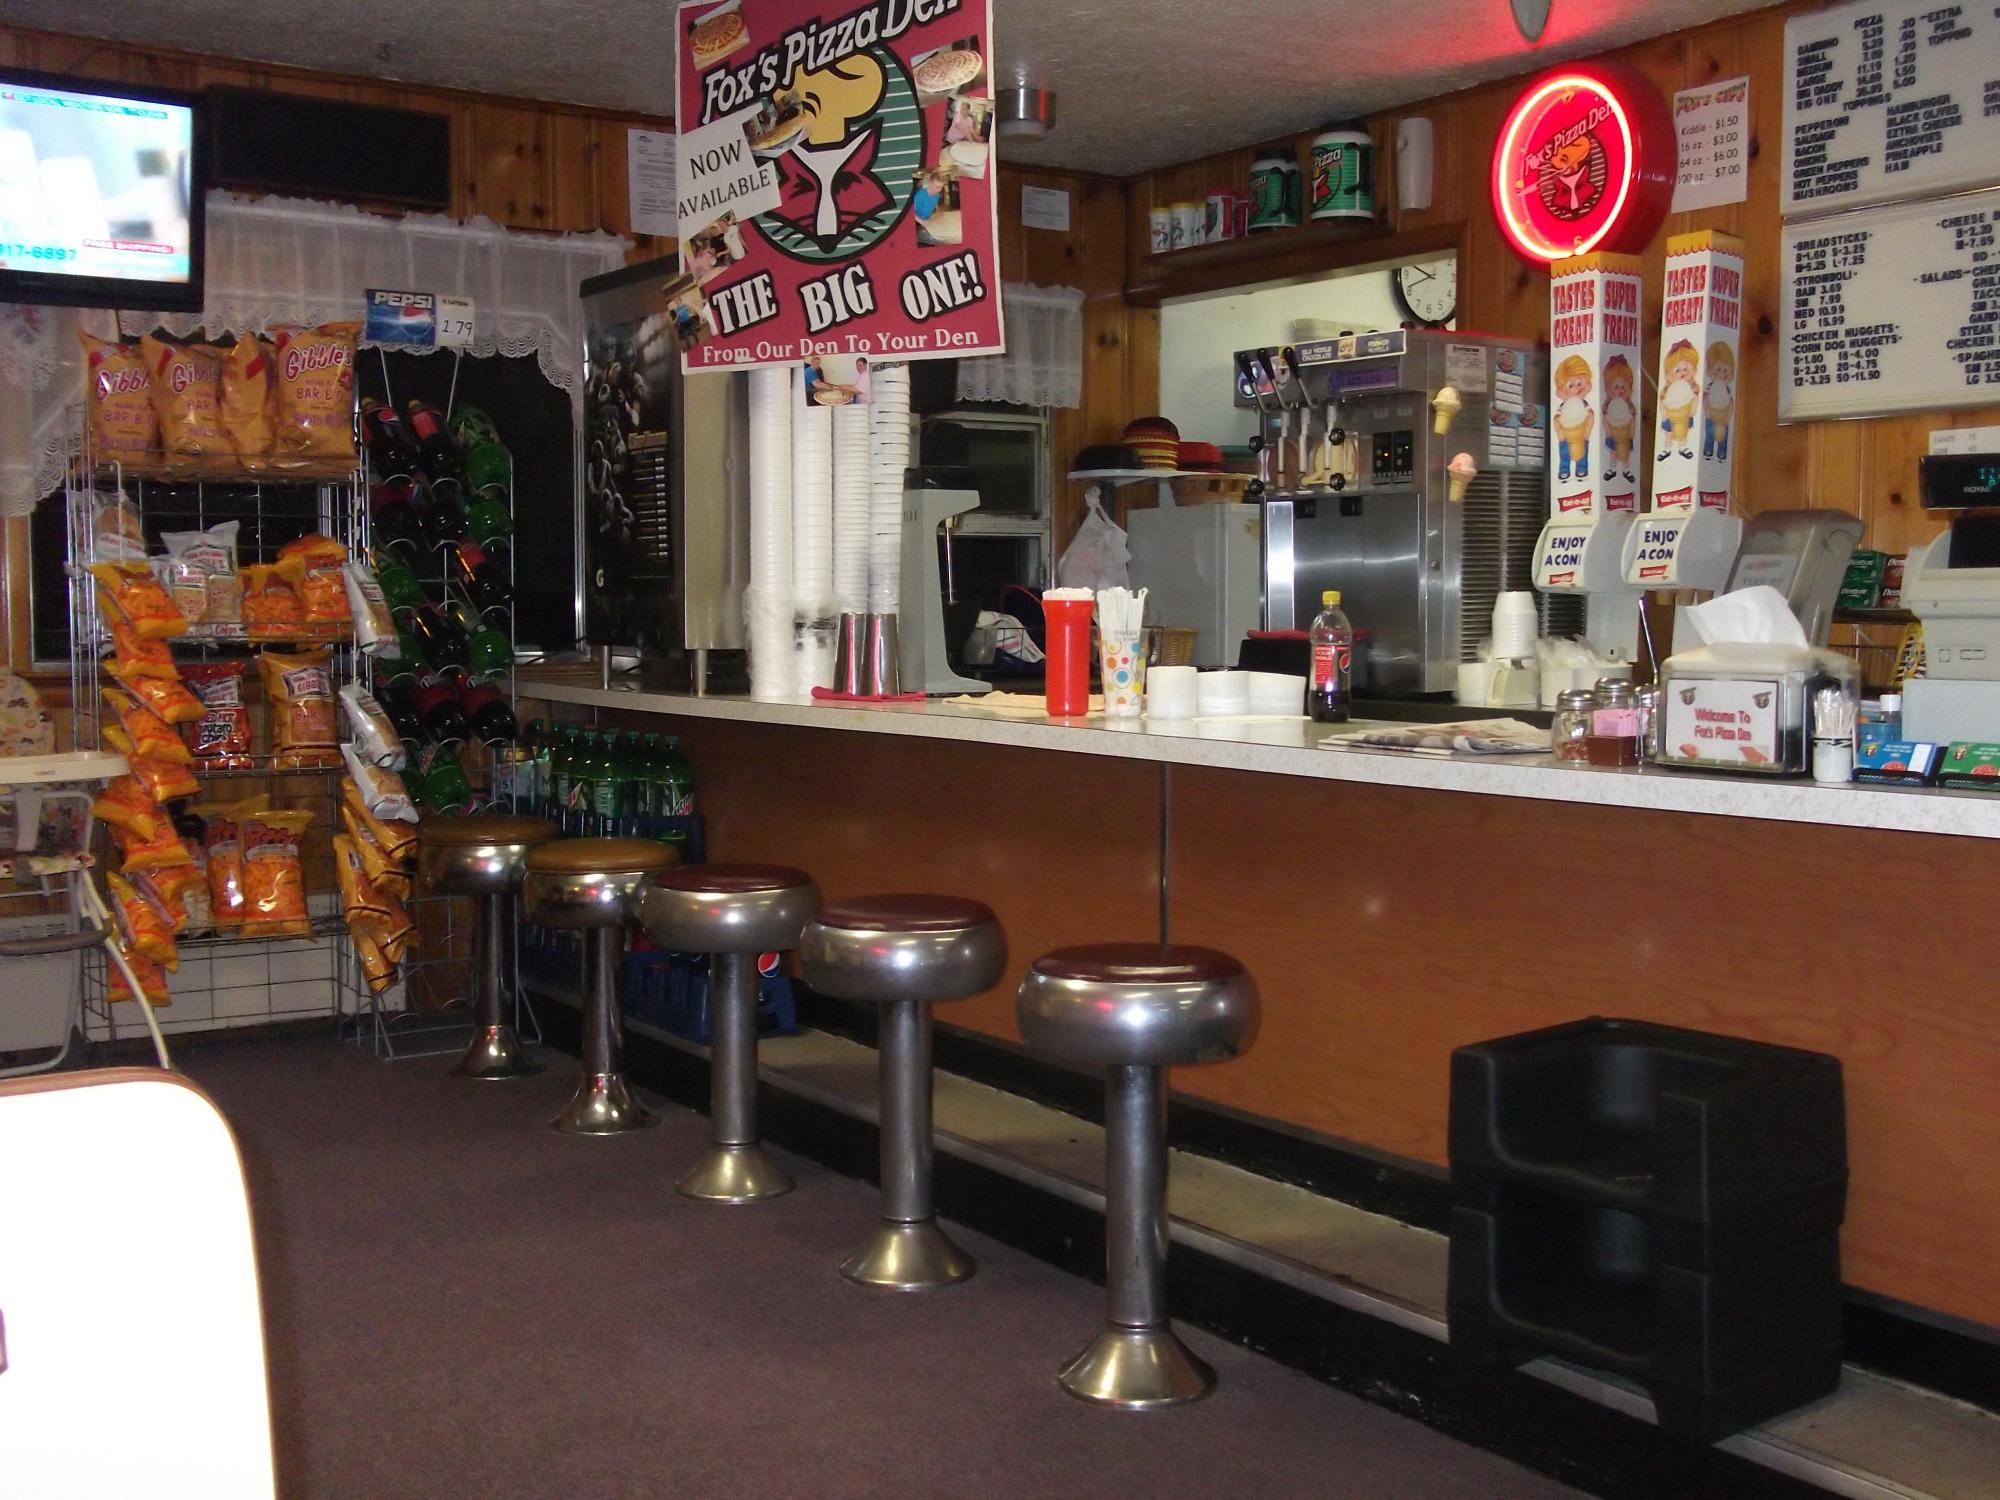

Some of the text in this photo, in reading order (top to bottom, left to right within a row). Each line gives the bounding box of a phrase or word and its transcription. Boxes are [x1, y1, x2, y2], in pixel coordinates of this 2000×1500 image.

[703, 0, 957, 124] Fox's Pizza Den
[1553, 120, 1588, 155] Pizza
[1794, 115, 1849, 135] PEPPERONI
[689, 139, 742, 180] NOW
[1793, 178, 1811, 190] HOT
[1884, 160, 1910, 174] HAM
[1826, 156, 1870, 173] PEPPERS
[677, 167, 771, 220] AVAILABLE
[1793, 180, 1859, 200] MUSHROOMS
[712, 253, 984, 335] THE BIG ONE!
[1553, 279, 1595, 315] TASTES
[1603, 280, 1637, 314] SUPER
[1666, 264, 1707, 298] TASTES
[1711, 266, 1740, 298] SUPER
[374, 291, 433, 309] PEPSI
[1665, 296, 1704, 328] GREAT!
[1710, 296, 1739, 330] TREAT!
[442, 319, 473, 337] 1.79
[1553, 313, 1594, 349] GREAT!
[1603, 314, 1638, 347] TREAT!
[703, 328, 979, 364] From Our Den To Your Den
[1824, 340, 1846, 351] DOG
[283, 343, 353, 382] Gibble's
[1545, 554, 1581, 566] A CON
[1552, 536, 1587, 552] ENJOY
[1637, 549, 1646, 561] A
[1694, 707, 1751, 724] Welcome To
[1694, 726, 1752, 741] Fox's Pizza Den
